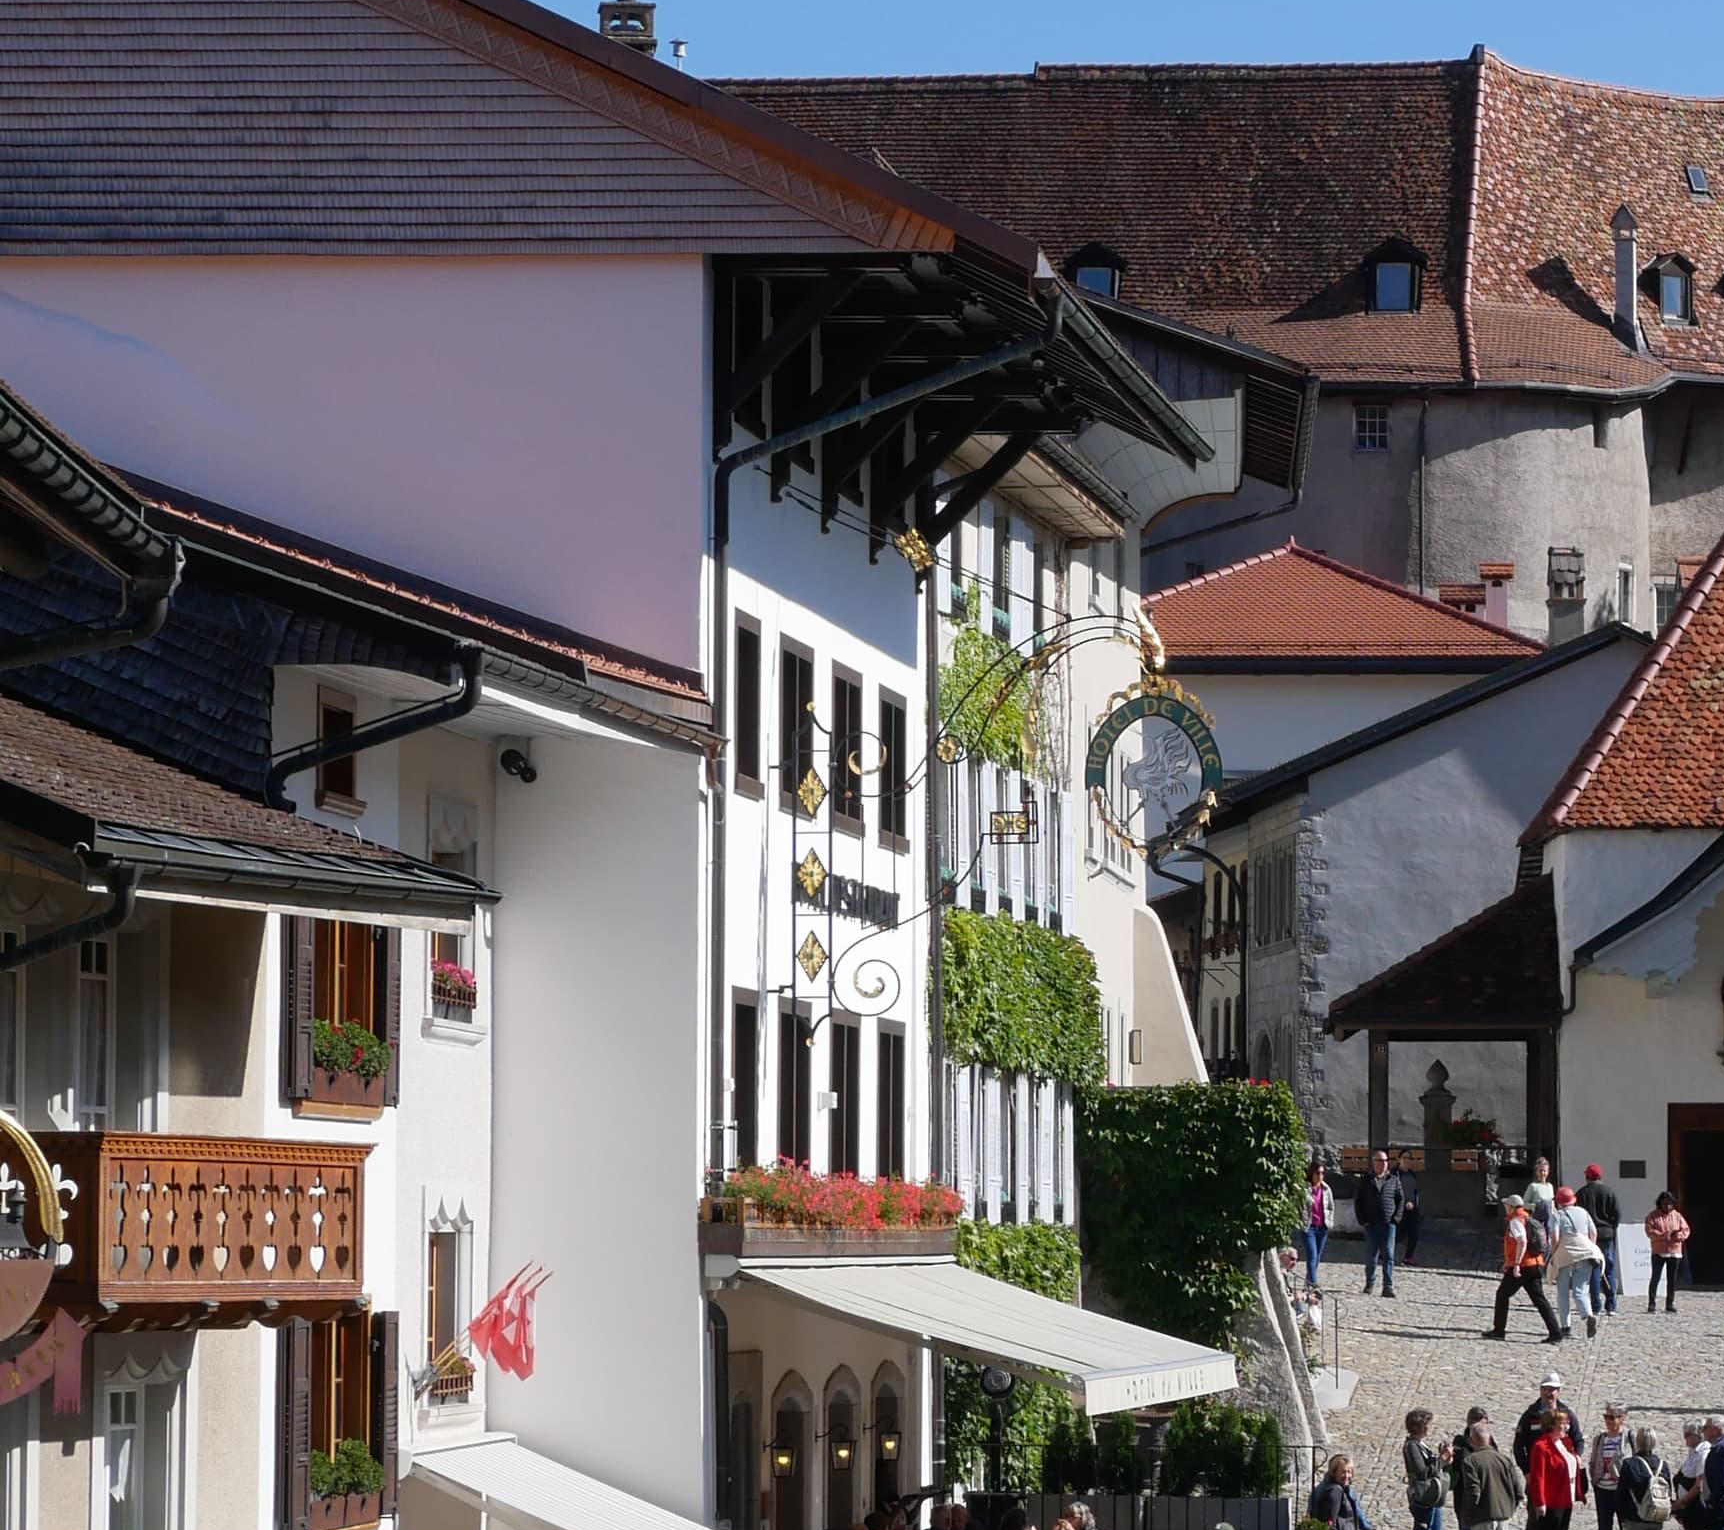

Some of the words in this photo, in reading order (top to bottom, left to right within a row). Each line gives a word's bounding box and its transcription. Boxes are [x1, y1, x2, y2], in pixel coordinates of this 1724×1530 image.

[1087, 706, 1139, 769] HOTEL
[1143, 697, 1177, 717] DE
[1181, 714, 1220, 769] VILLE
